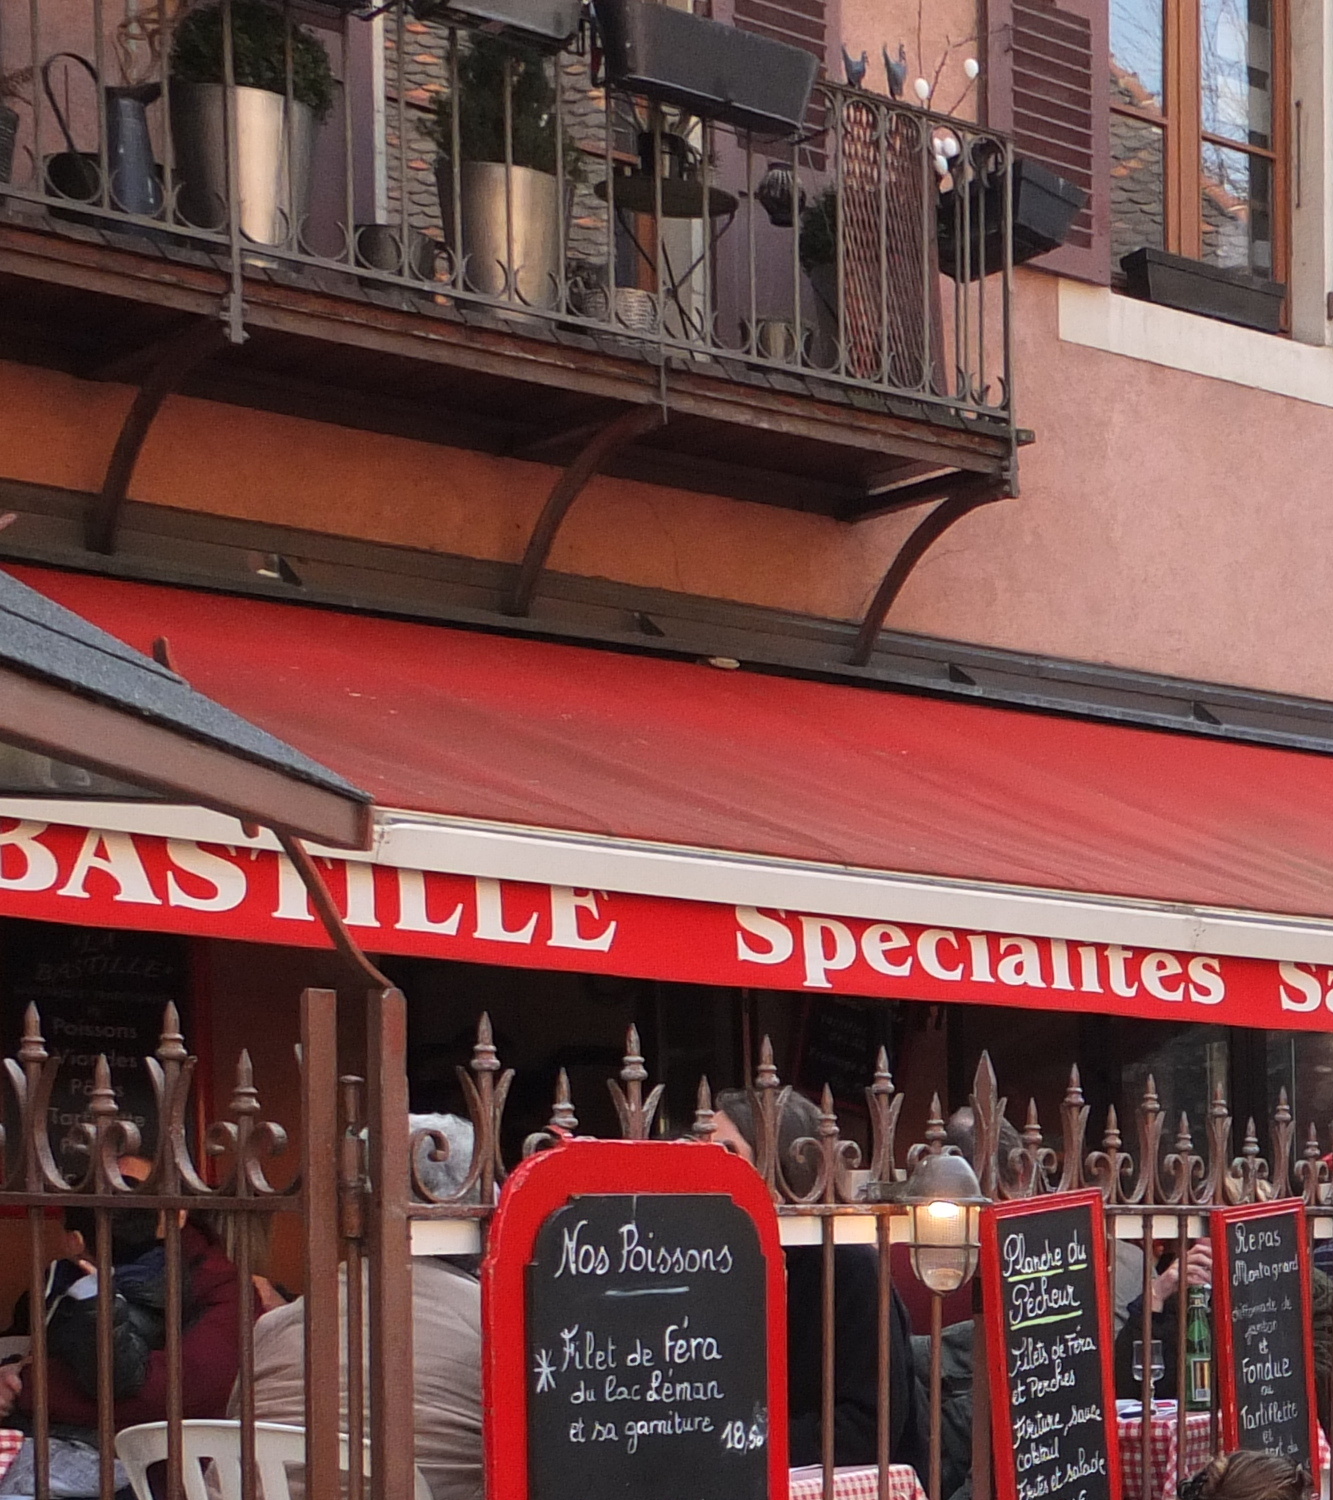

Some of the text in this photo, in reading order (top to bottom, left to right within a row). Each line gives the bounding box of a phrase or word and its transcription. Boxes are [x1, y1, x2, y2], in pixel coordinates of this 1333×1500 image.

[555, 1219, 734, 1279] Nos Poissons
[1003, 1228, 1088, 1278] Planche du
[1234, 1222, 1282, 1255] Repas
[560, 1314, 723, 1373] Filet de Féra
[1008, 1336, 1050, 1378] Filets
[1051, 1335, 1067, 1361] de
[1258, 1336, 1270, 1355] et
[570, 1367, 726, 1405] du lac Léman
[1012, 1358, 1077, 1406] et Perches
[1241, 1353, 1293, 1385] Fondue
[569, 1417, 587, 1444] et
[591, 1420, 620, 1442] sa
[624, 1409, 716, 1455] garniture
[1240, 1400, 1299, 1431] Tartiflette
[1051, 1465, 1064, 1492] et
[1063, 1447, 1107, 1484] salade
